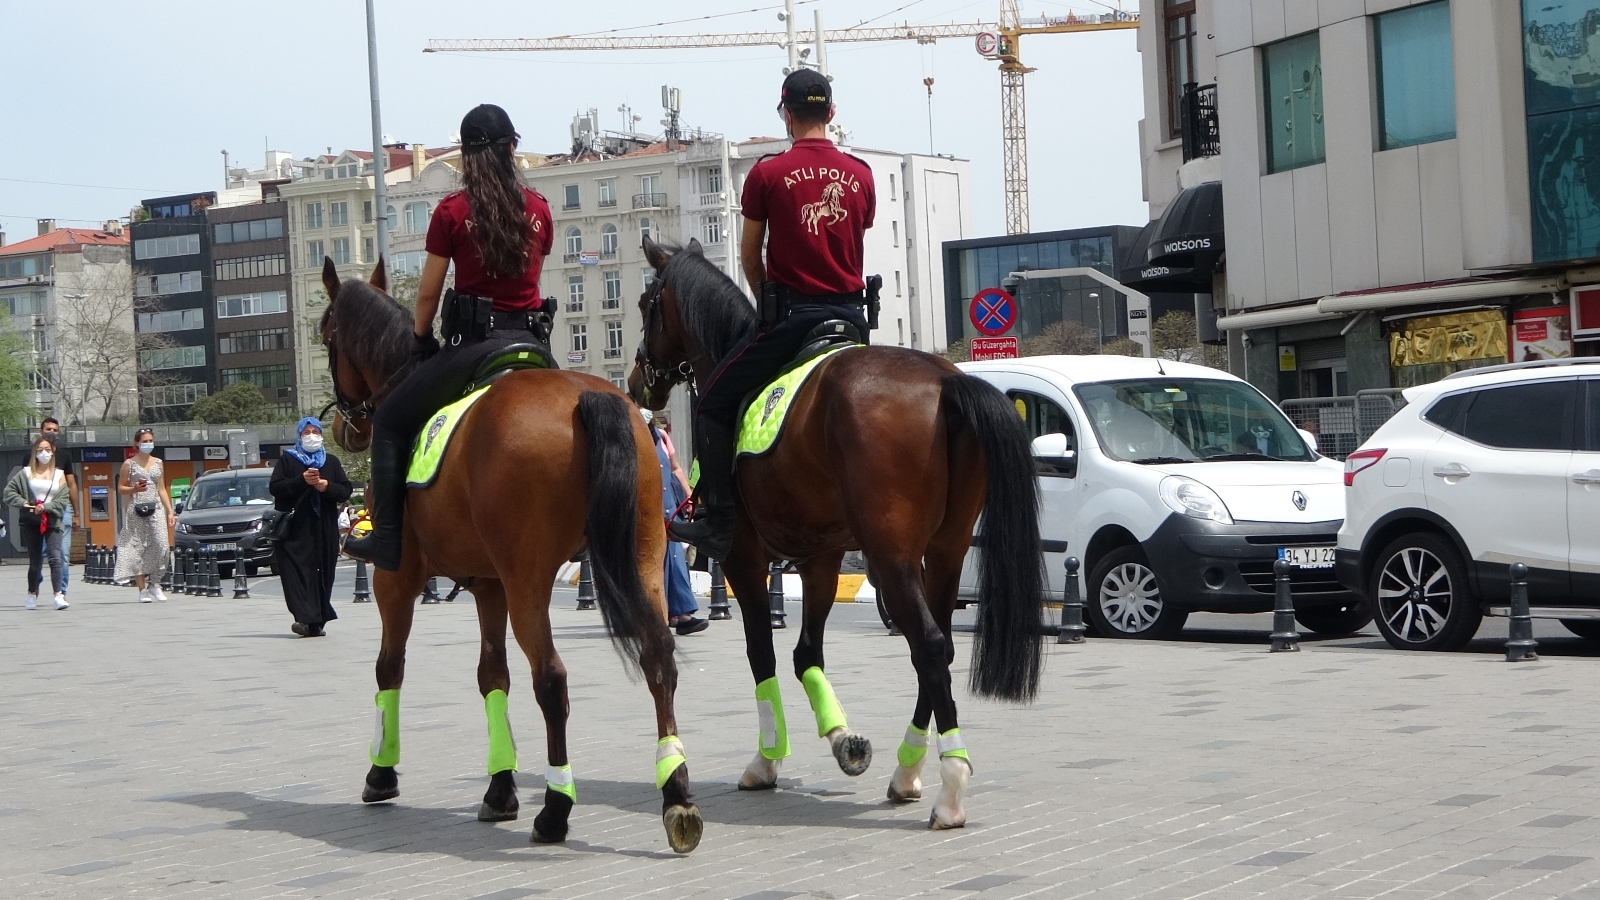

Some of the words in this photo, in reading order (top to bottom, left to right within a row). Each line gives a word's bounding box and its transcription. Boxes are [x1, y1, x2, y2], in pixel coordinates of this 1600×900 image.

[783, 166, 815, 190] ATLI
[818, 167, 860, 193] POLİS
[1164, 238, 1211, 253] watsons
[1140, 266, 1170, 279] watsons
[973, 341, 981, 349] Bu
[982, 340, 1016, 350] Güzergahta
[975, 353, 992, 361] Mobil
[993, 352, 1006, 360] EDS
[1286, 549, 1299, 563] 34
[1304, 549, 1318, 563] YJ
